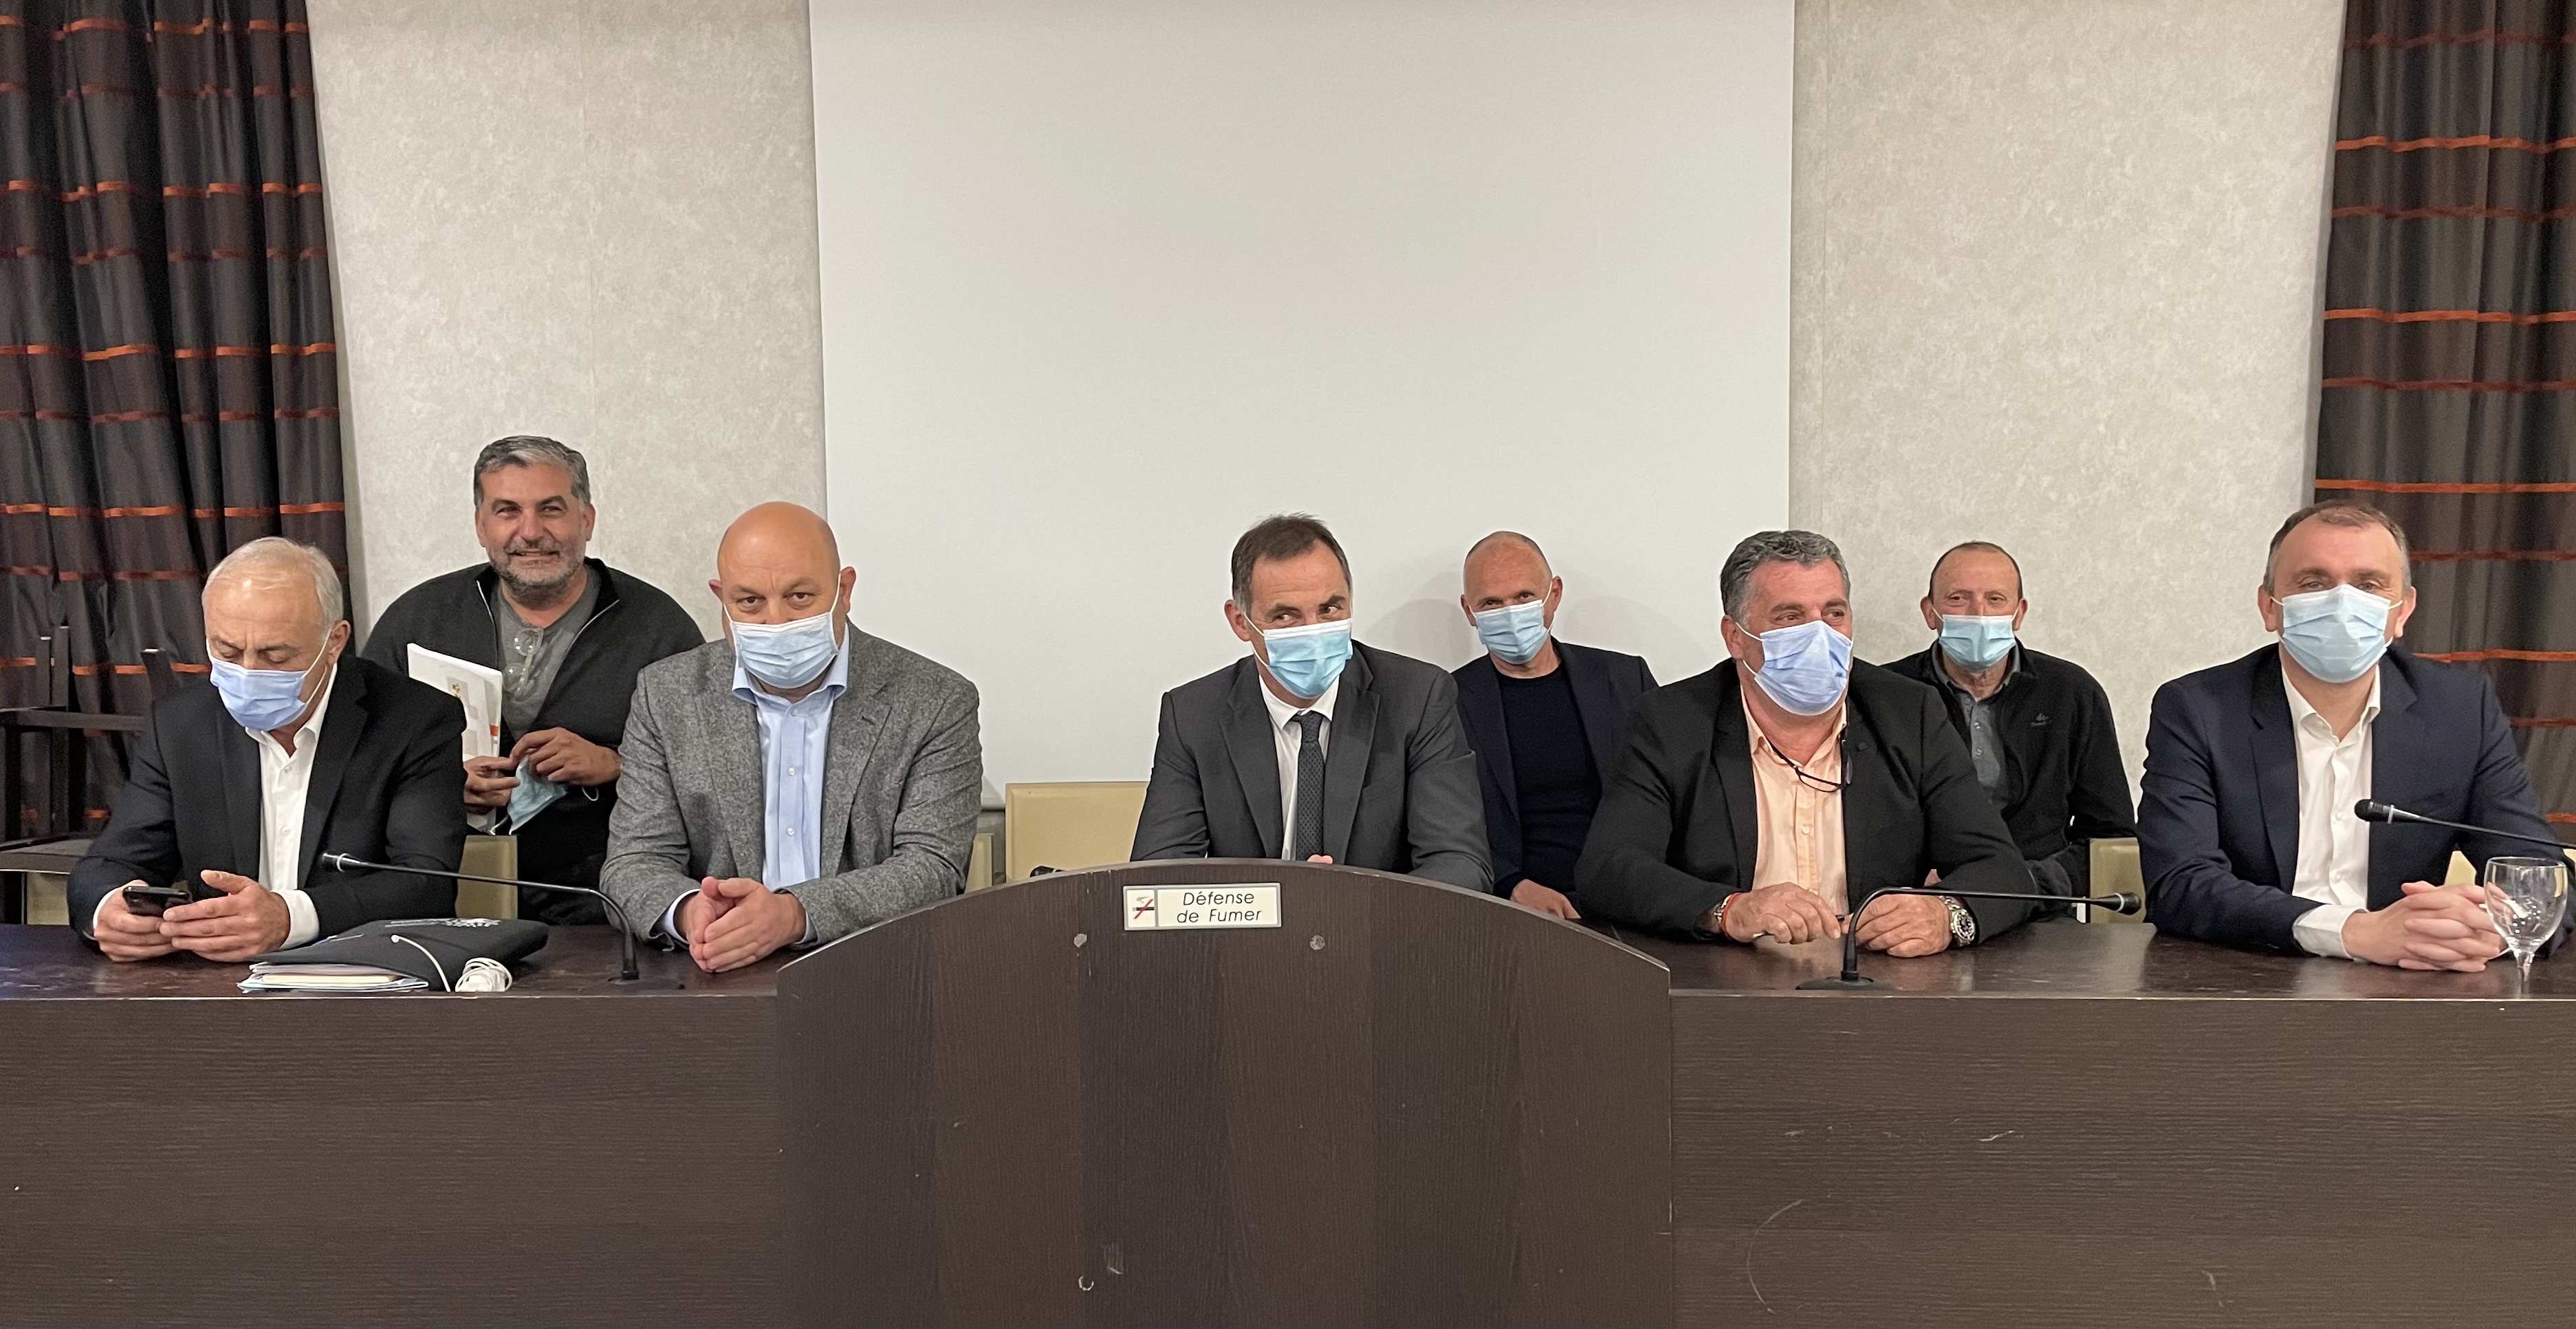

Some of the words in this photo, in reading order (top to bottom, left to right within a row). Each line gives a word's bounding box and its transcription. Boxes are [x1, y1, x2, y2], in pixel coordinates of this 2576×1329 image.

[1183, 891, 1254, 905] Défense
[1177, 910, 1199, 923] de
[1209, 909, 1262, 922] Fumer
